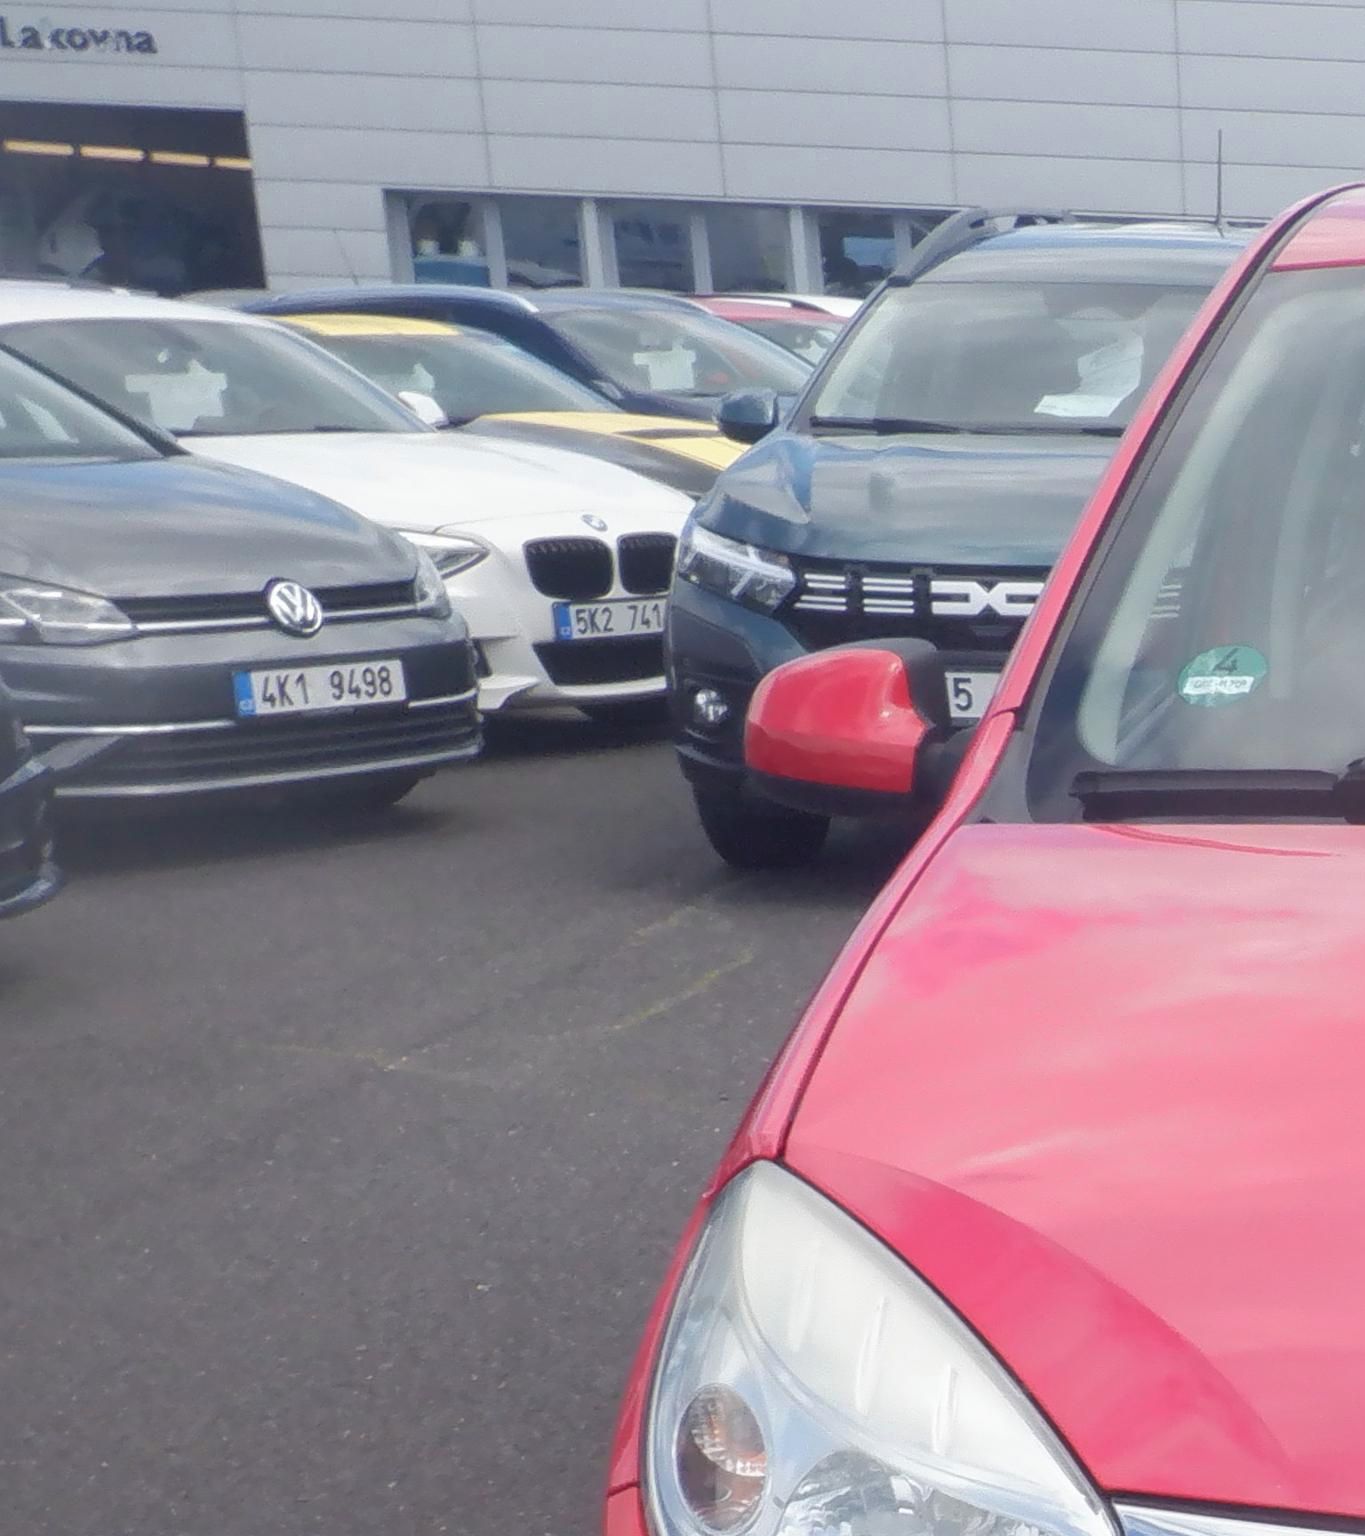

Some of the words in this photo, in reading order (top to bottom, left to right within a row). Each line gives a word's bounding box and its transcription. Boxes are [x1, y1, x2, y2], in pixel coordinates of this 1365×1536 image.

[575, 607, 614, 634] 5K2
[1212, 647, 1239, 674] 4
[261, 672, 310, 709] 4K1
[329, 664, 393, 702] 9498
